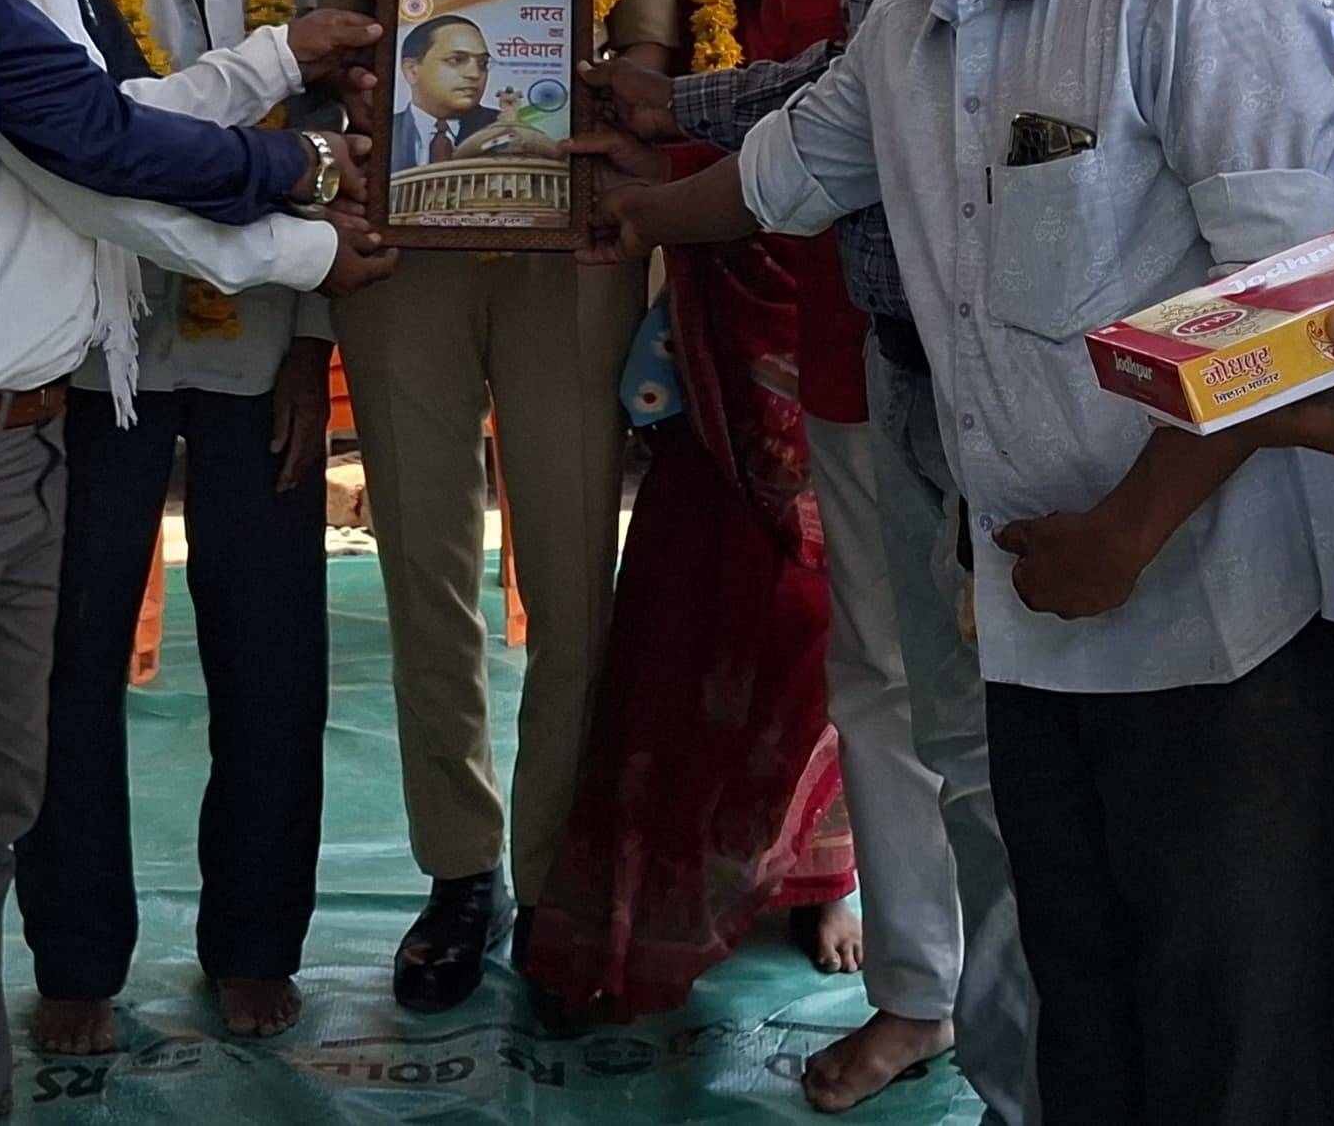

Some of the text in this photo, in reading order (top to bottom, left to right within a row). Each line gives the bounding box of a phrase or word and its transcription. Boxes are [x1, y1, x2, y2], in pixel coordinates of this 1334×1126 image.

[520, 6, 565, 22] भारत
[496, 36, 564, 59] संविधान
[1112, 350, 1154, 382] Jodhpur
[1201, 346, 1273, 387] जोधपुर
[32, 1064, 109, 1102] RS
